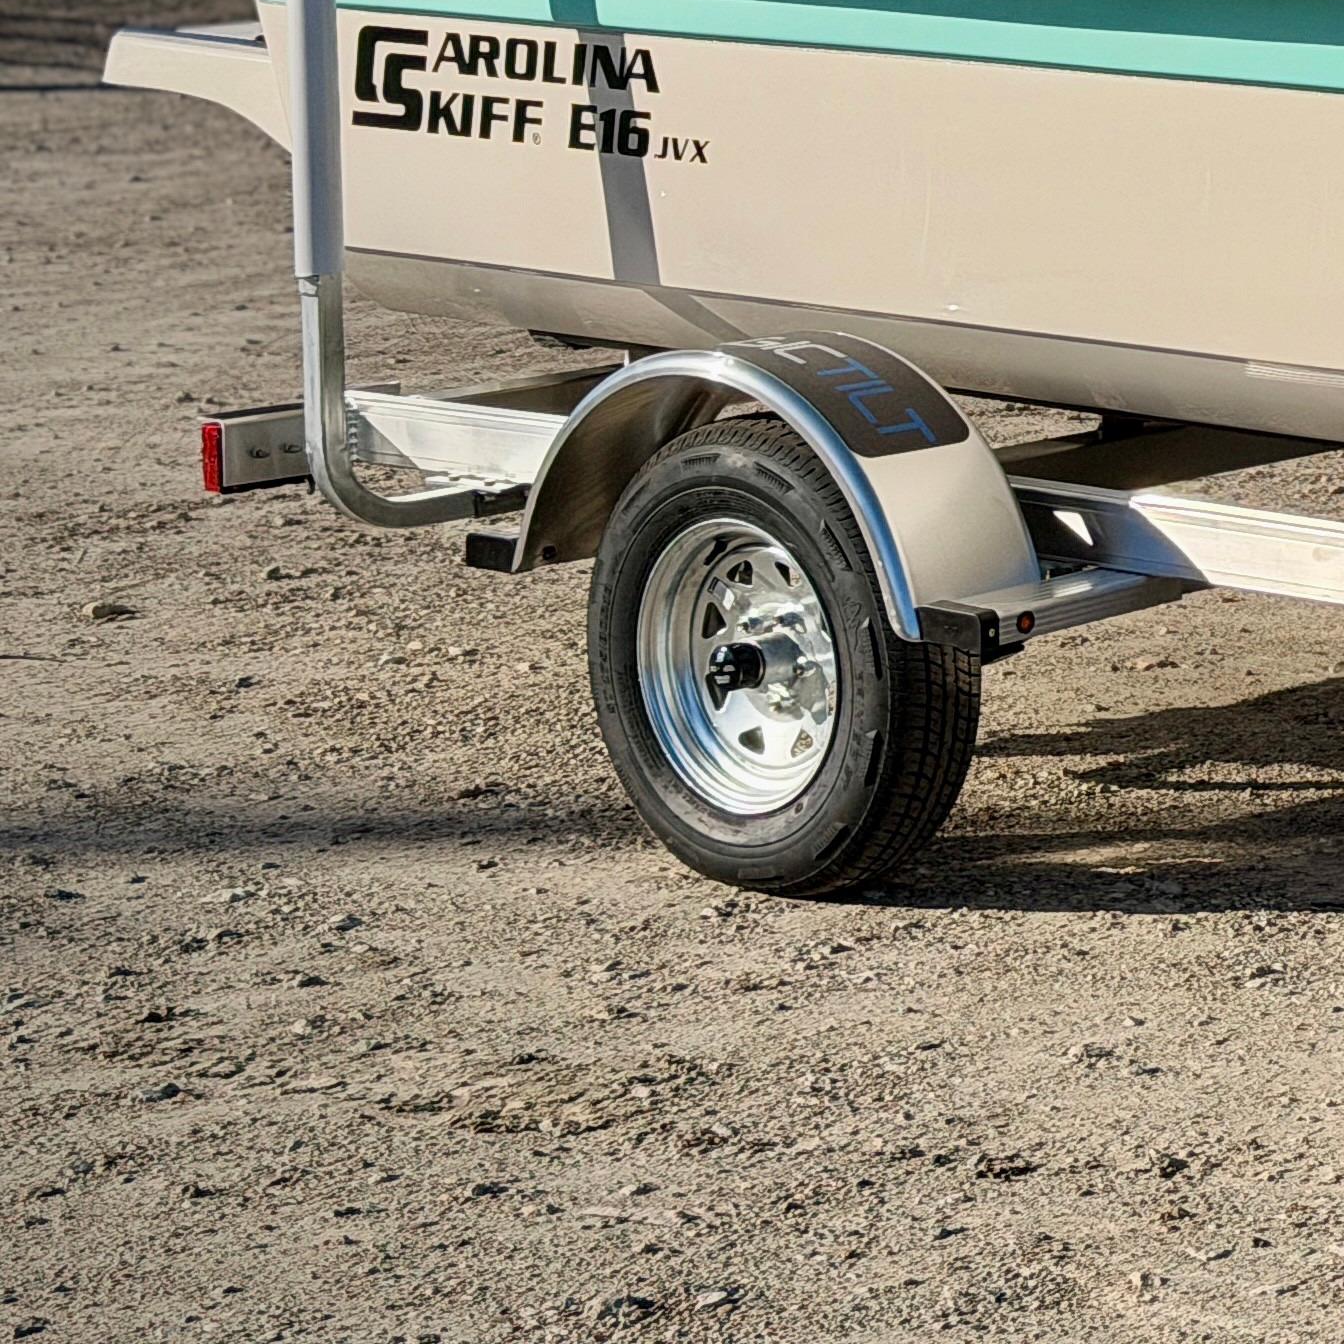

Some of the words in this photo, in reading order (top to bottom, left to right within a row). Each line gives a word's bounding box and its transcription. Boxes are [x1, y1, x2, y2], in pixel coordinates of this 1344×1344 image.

[351, 52, 544, 144] SKIFF
[567, 103, 652, 158] E16
[653, 136, 711, 164] JVX
[354, 24, 661, 103] CAROLINA
